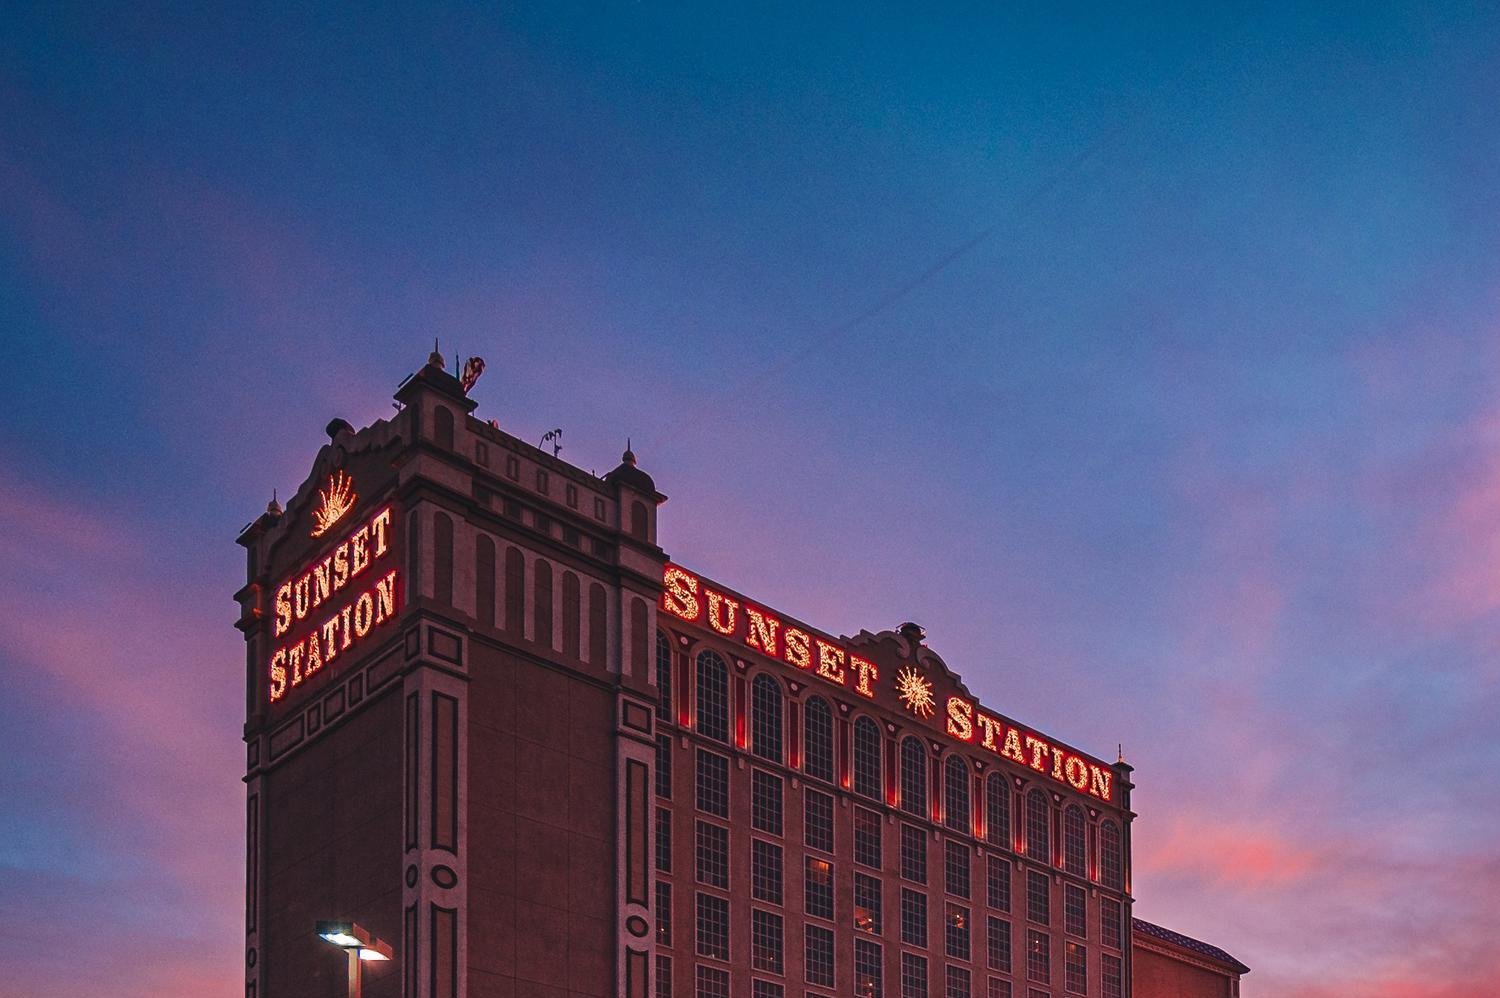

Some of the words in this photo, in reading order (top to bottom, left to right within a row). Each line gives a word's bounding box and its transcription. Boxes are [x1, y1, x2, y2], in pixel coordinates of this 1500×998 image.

[270, 570, 398, 702] STATION
[275, 508, 391, 638] SUNSET
[664, 566, 878, 698] SUNSET
[945, 697, 1113, 801] STATION
